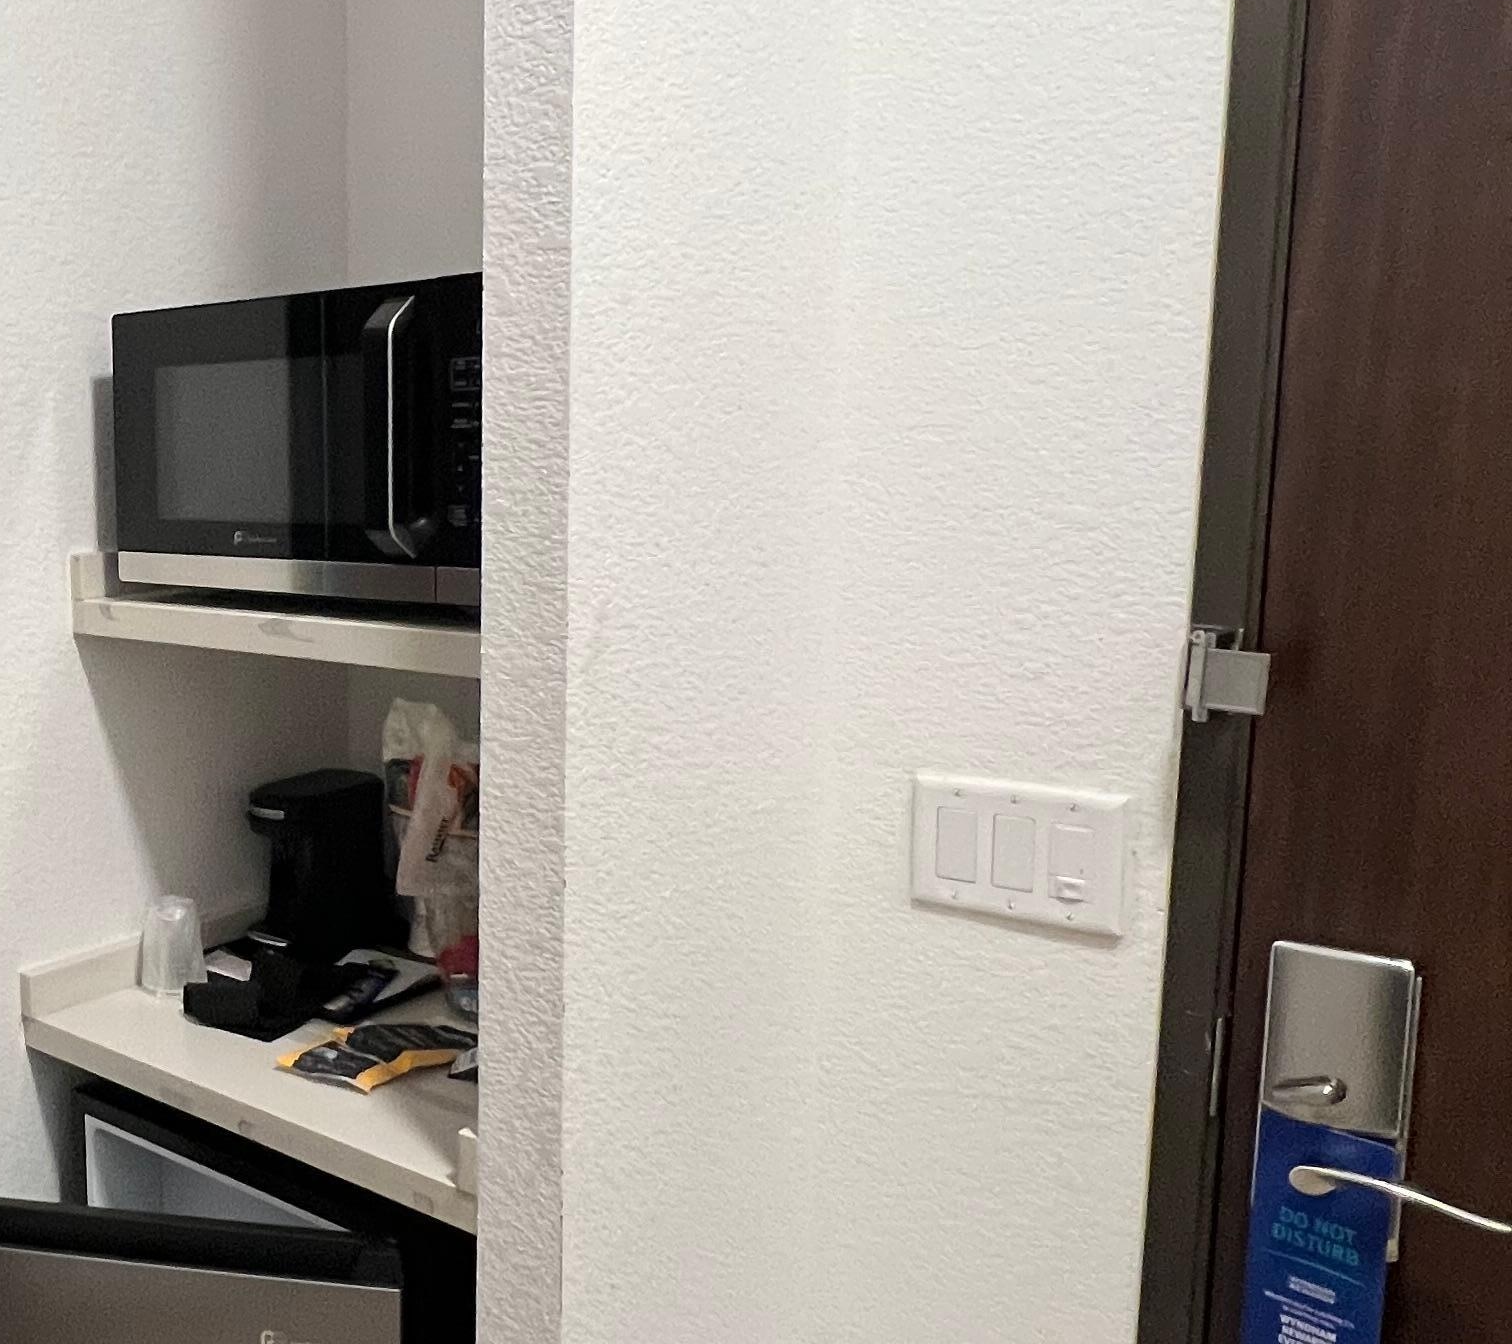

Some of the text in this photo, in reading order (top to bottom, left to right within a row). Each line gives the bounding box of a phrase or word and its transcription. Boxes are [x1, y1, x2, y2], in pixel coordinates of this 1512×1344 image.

[1271, 1223, 1360, 1265] DISTURB
[1280, 1206, 1357, 1245] DO NOT
